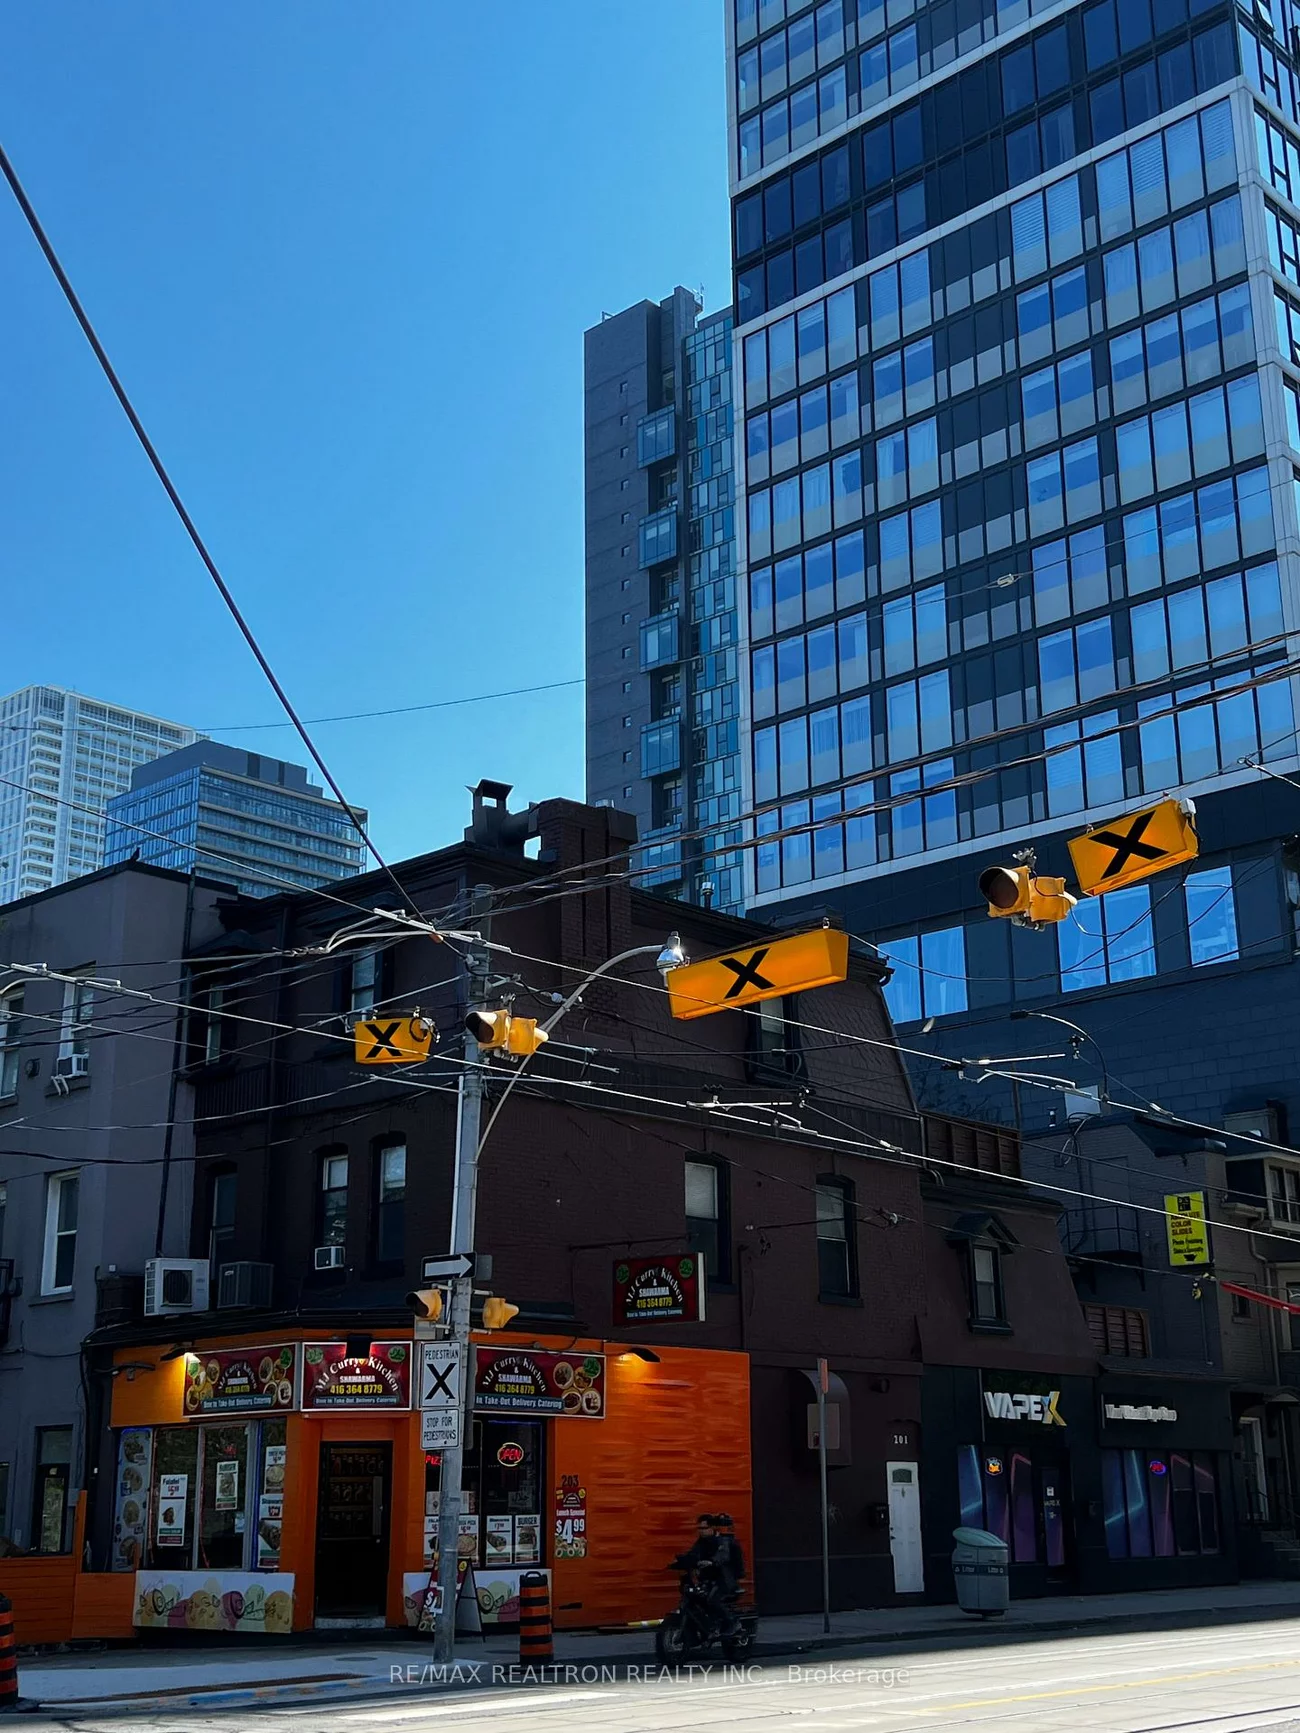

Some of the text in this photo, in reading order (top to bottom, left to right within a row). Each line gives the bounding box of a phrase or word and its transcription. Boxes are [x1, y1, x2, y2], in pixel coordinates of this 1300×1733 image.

[635, 1268, 655, 1287] Curry
[661, 1267, 683, 1302] Kitchen
[636, 1299, 646, 1308] 416
[425, 1349, 459, 1360] PEDESTRIAN
[329, 1357, 358, 1374] Curry
[367, 1356, 399, 1392] Kitchen
[339, 1375, 376, 1383] SHAWARMA
[494, 1357, 516, 1372] Curry
[523, 1357, 547, 1392] Kitchen
[498, 1373, 532, 1384] SHAWARMA
[330, 1383, 383, 1394] 416 364 8779
[494, 1383, 535, 1395] 416 364 8779
[538, 1399, 562, 1410] Catering
[426, 1416, 453, 1428] STOP FOR
[423, 1430, 457, 1441] PEDESTRIANS
[562, 1475, 579, 1487] 203
